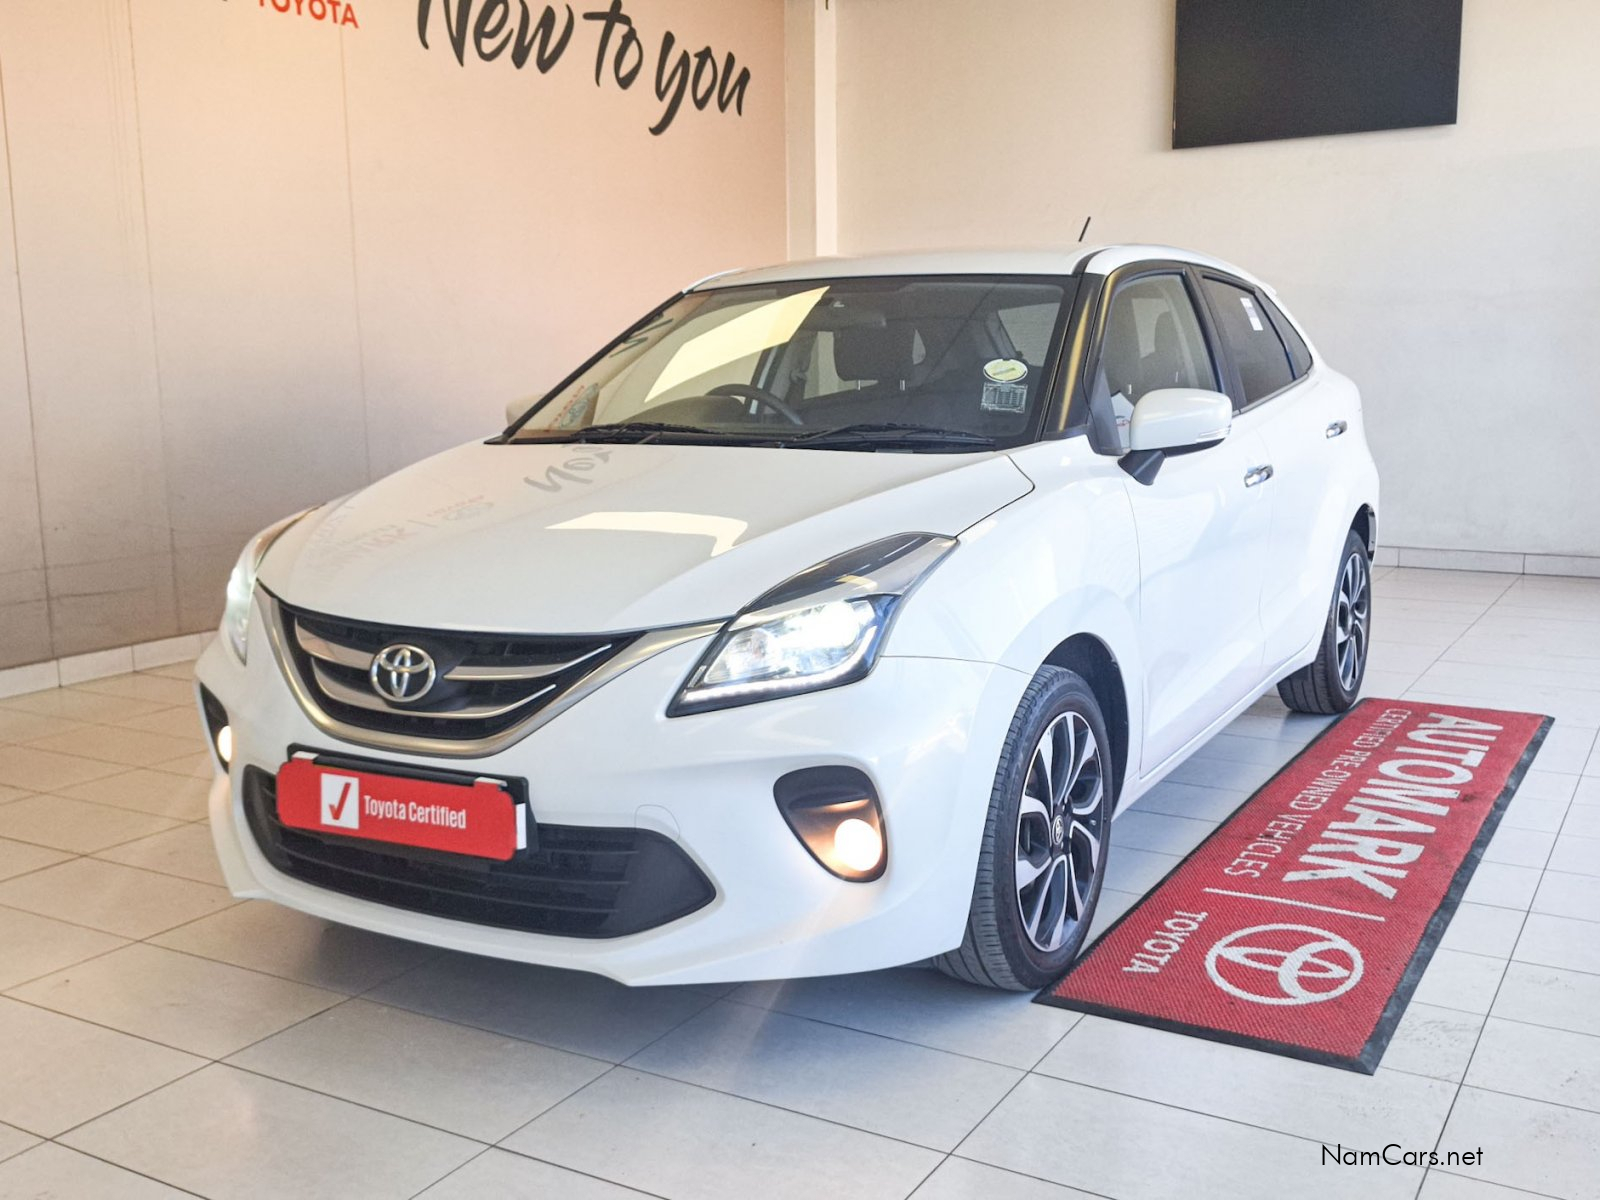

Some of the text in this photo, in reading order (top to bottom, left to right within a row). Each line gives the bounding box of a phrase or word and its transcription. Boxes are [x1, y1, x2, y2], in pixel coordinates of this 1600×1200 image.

[417, 0, 751, 136] New to you
[363, 795, 466, 829] Toyota Certified
[1224, 708, 1412, 878] CERTIFIED PRE-OWNED VEHICLES
[1282, 712, 1504, 900] AUTOMARK
[1122, 909, 1208, 973] TOYOTA
